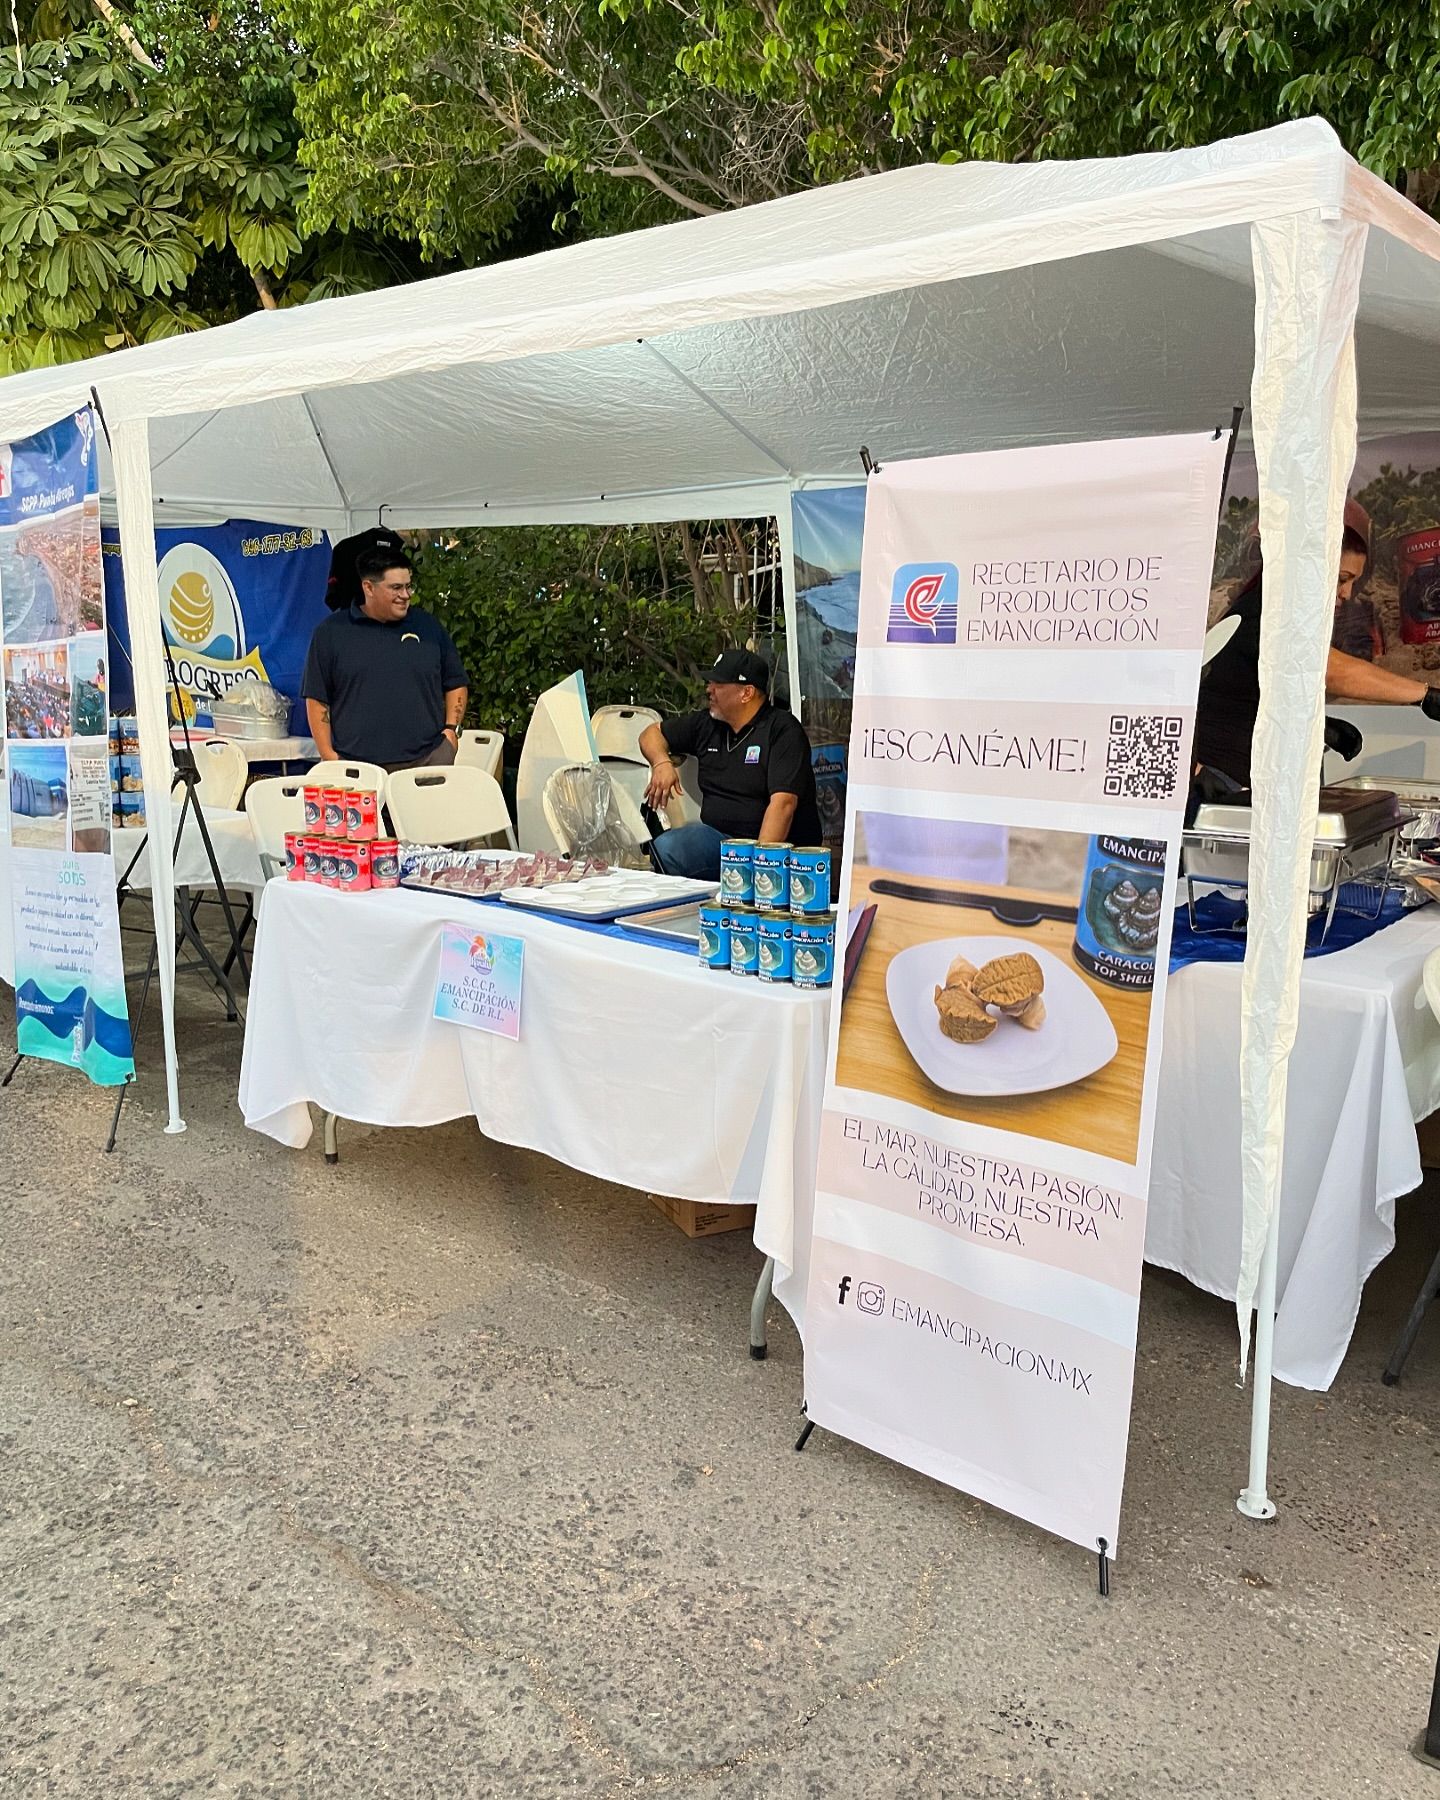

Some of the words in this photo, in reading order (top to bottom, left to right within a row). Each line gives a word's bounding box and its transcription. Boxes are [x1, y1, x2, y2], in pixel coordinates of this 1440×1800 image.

[972, 559, 1118, 585] RECETARIO
[1126, 556, 1163, 581] DE
[980, 587, 1148, 614] PRODUCTOS
[967, 614, 1159, 642] EMANCIPACIÓN
[864, 728, 1087, 773] ¡ESCANÉAME!
[462, 975, 497, 994] S.C.C.P.
[1093, 960, 1117, 978] TOP
[1119, 972, 1153, 985] SHELL
[451, 998, 469, 1012] S.C.
[472, 1004, 486, 1017] DE
[843, 1117, 869, 1143] EL
[923, 1141, 1025, 1191] NUESTRA
[1031, 1171, 1124, 1221] PASIÓN.
[862, 1147, 888, 1175] LA
[984, 1190, 1100, 1240] NUESTRA
[918, 1191, 1025, 1246] PROMESA.
[892, 1297, 1093, 1395] EMANCIPACION.MX
